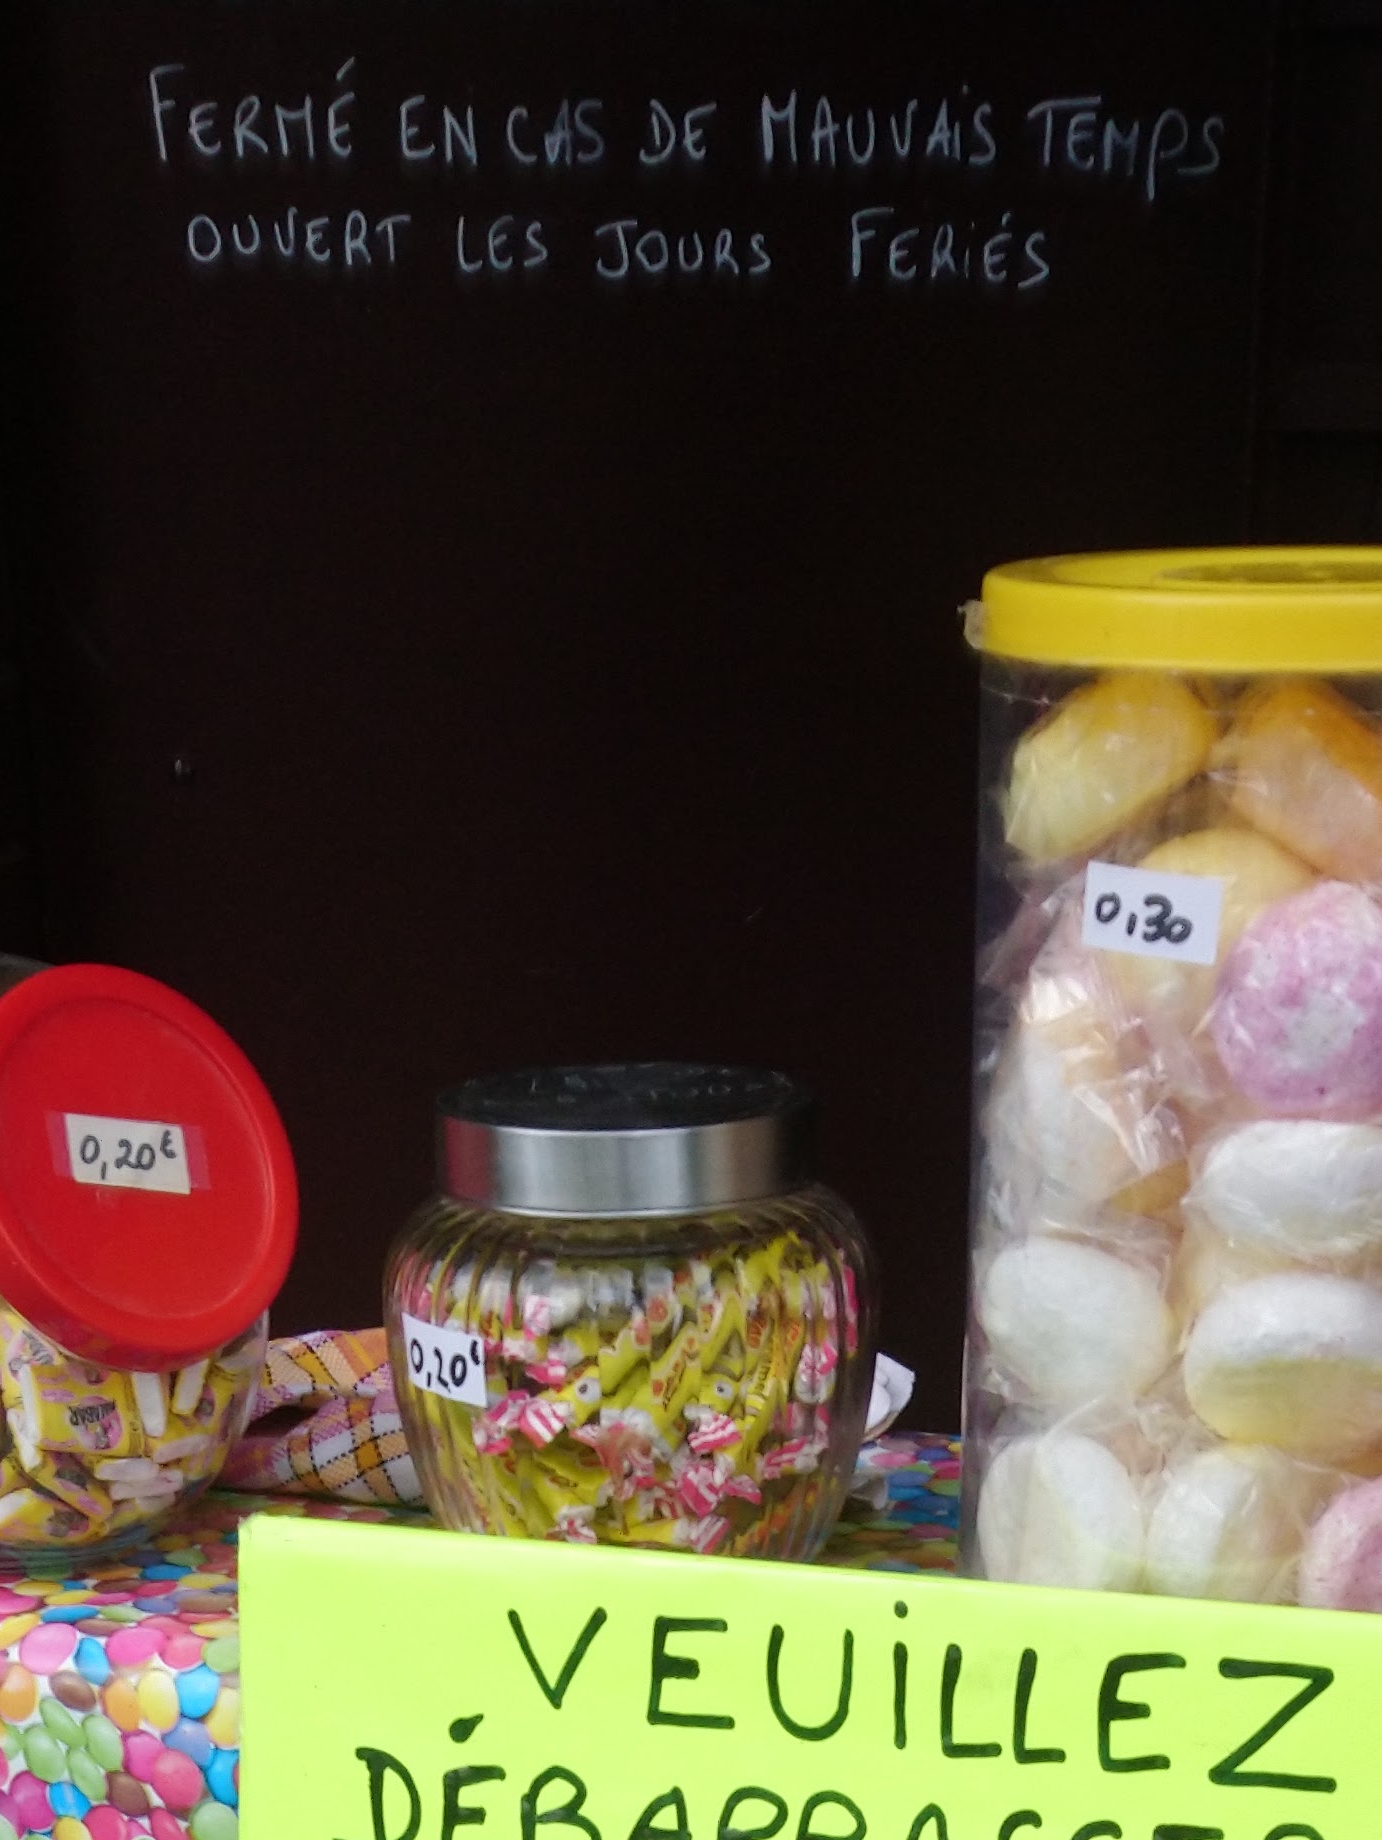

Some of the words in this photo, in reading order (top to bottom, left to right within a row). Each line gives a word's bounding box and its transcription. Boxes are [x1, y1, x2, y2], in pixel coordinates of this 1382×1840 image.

[149, 56, 356, 164] FERMÉ
[400, 94, 478, 165] EN
[506, 97, 605, 165] CAS
[639, 99, 718, 165] DE
[1027, 95, 1224, 201] TEMPS
[186, 207, 411, 268] OUVERT
[456, 214, 549, 273] LES
[595, 218, 773, 281] JOURS
[1094, 892, 1194, 946] 0,30
[79, 1129, 178, 1181] 0,20€
